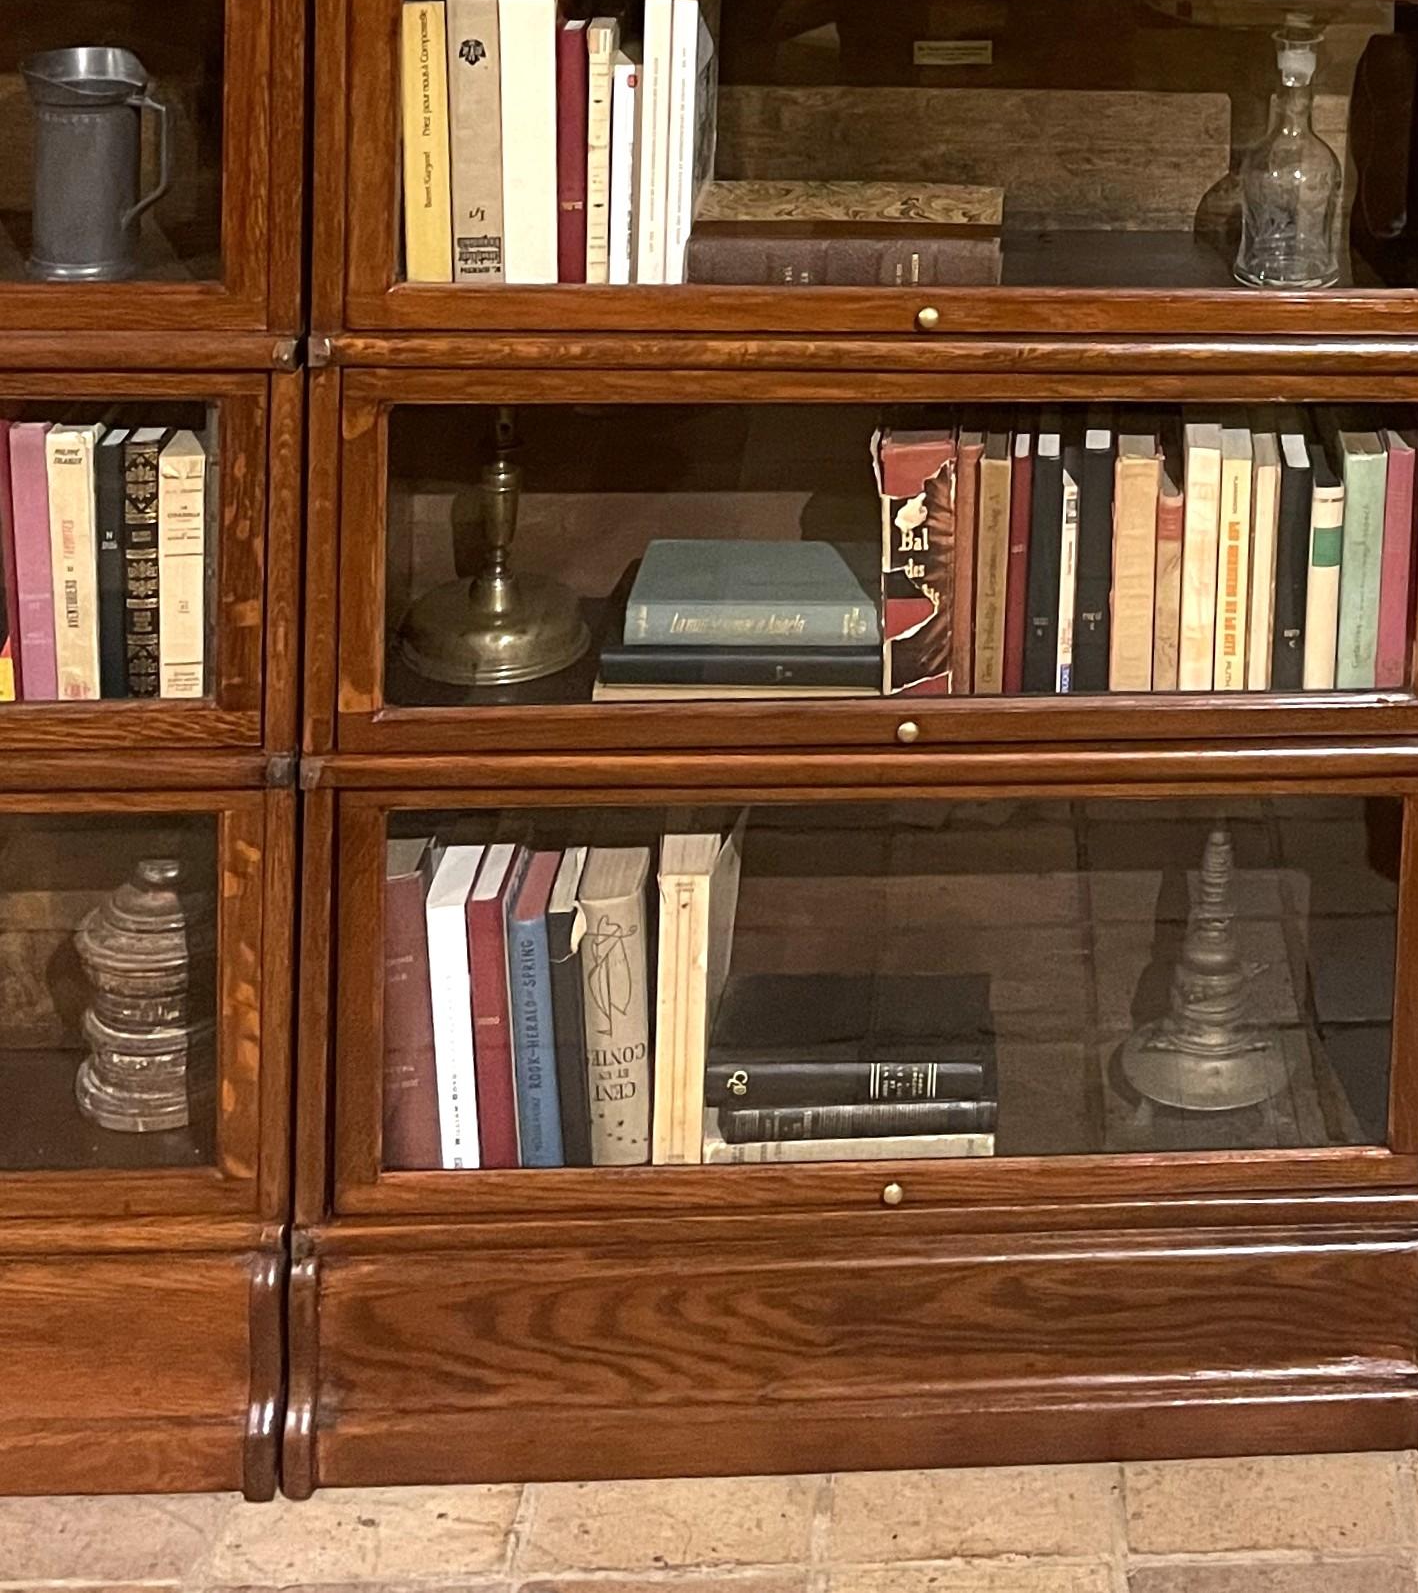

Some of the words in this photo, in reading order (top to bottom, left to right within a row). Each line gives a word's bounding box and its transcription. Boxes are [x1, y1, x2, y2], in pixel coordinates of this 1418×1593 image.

[421, 71, 430, 92] nous
[422, 92, 433, 114] pour
[421, 116, 431, 137] Priez
[898, 527, 929, 552] Bal
[905, 558, 926, 579] des
[520, 939, 537, 988] SPRING
[587, 1042, 646, 1068] CONTE
[598, 1069, 613, 1081] UN
[617, 1067, 630, 1079] ET
[593, 1081, 637, 1102] CENT
